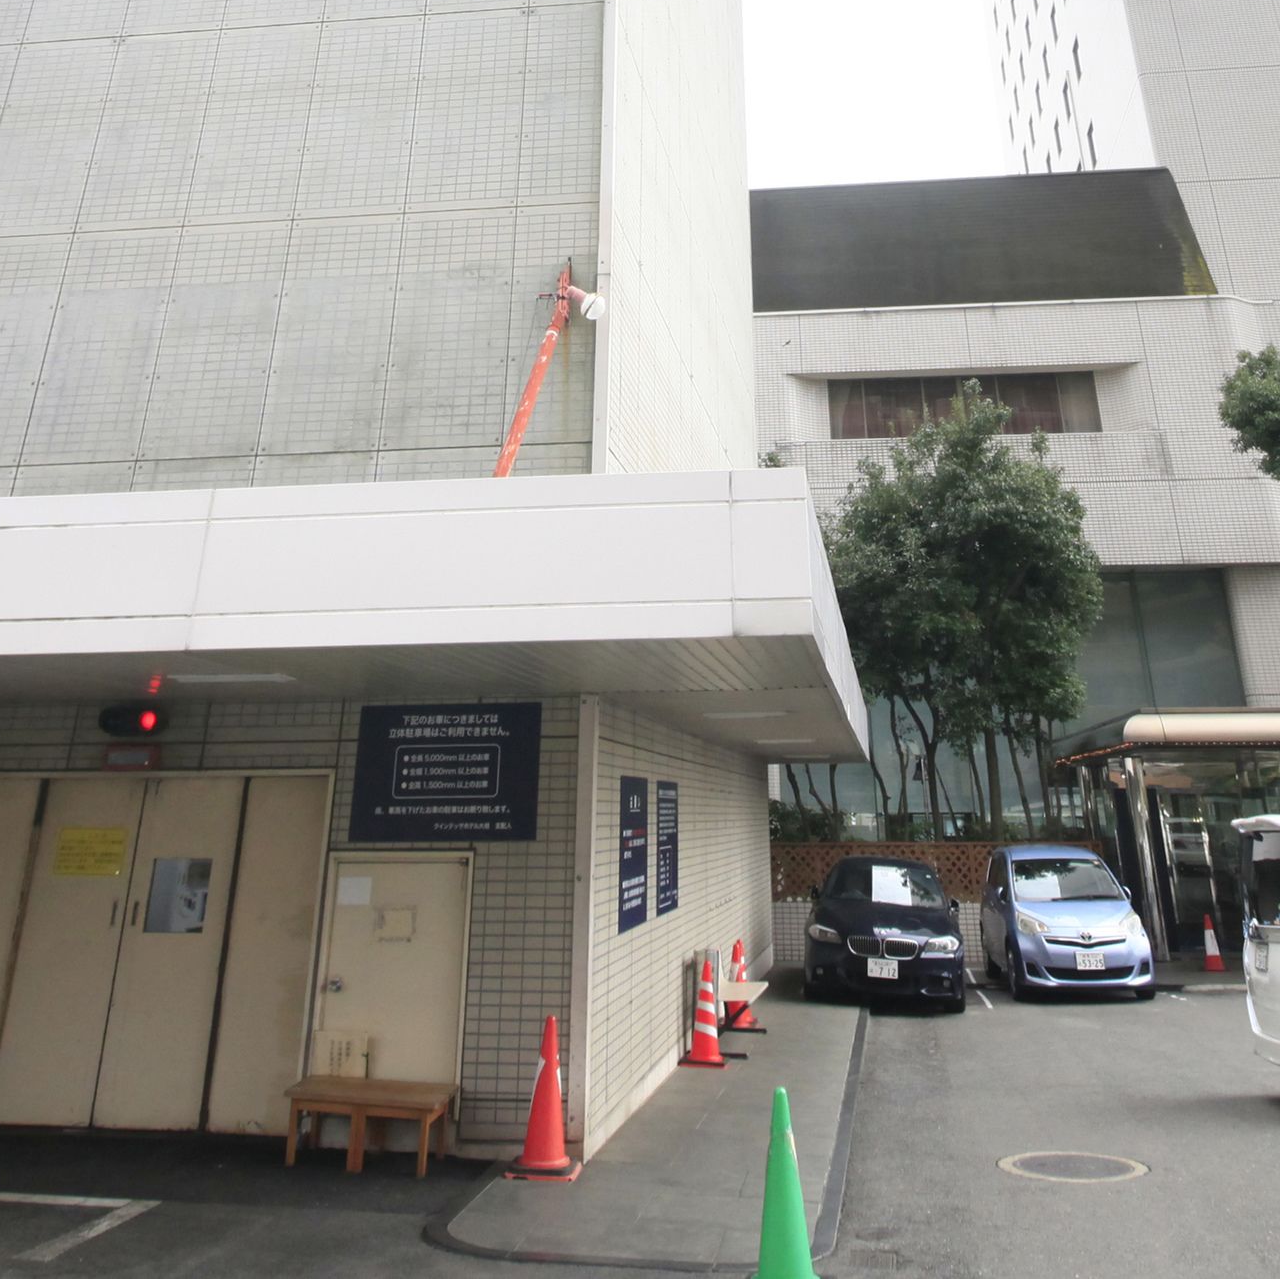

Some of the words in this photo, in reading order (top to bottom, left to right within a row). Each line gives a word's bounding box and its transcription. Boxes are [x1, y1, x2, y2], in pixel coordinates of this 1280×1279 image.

[401, 713, 499, 725] 下記のお車につきましては
[388, 725, 511, 739] 立体駐車場はご利用できません。
